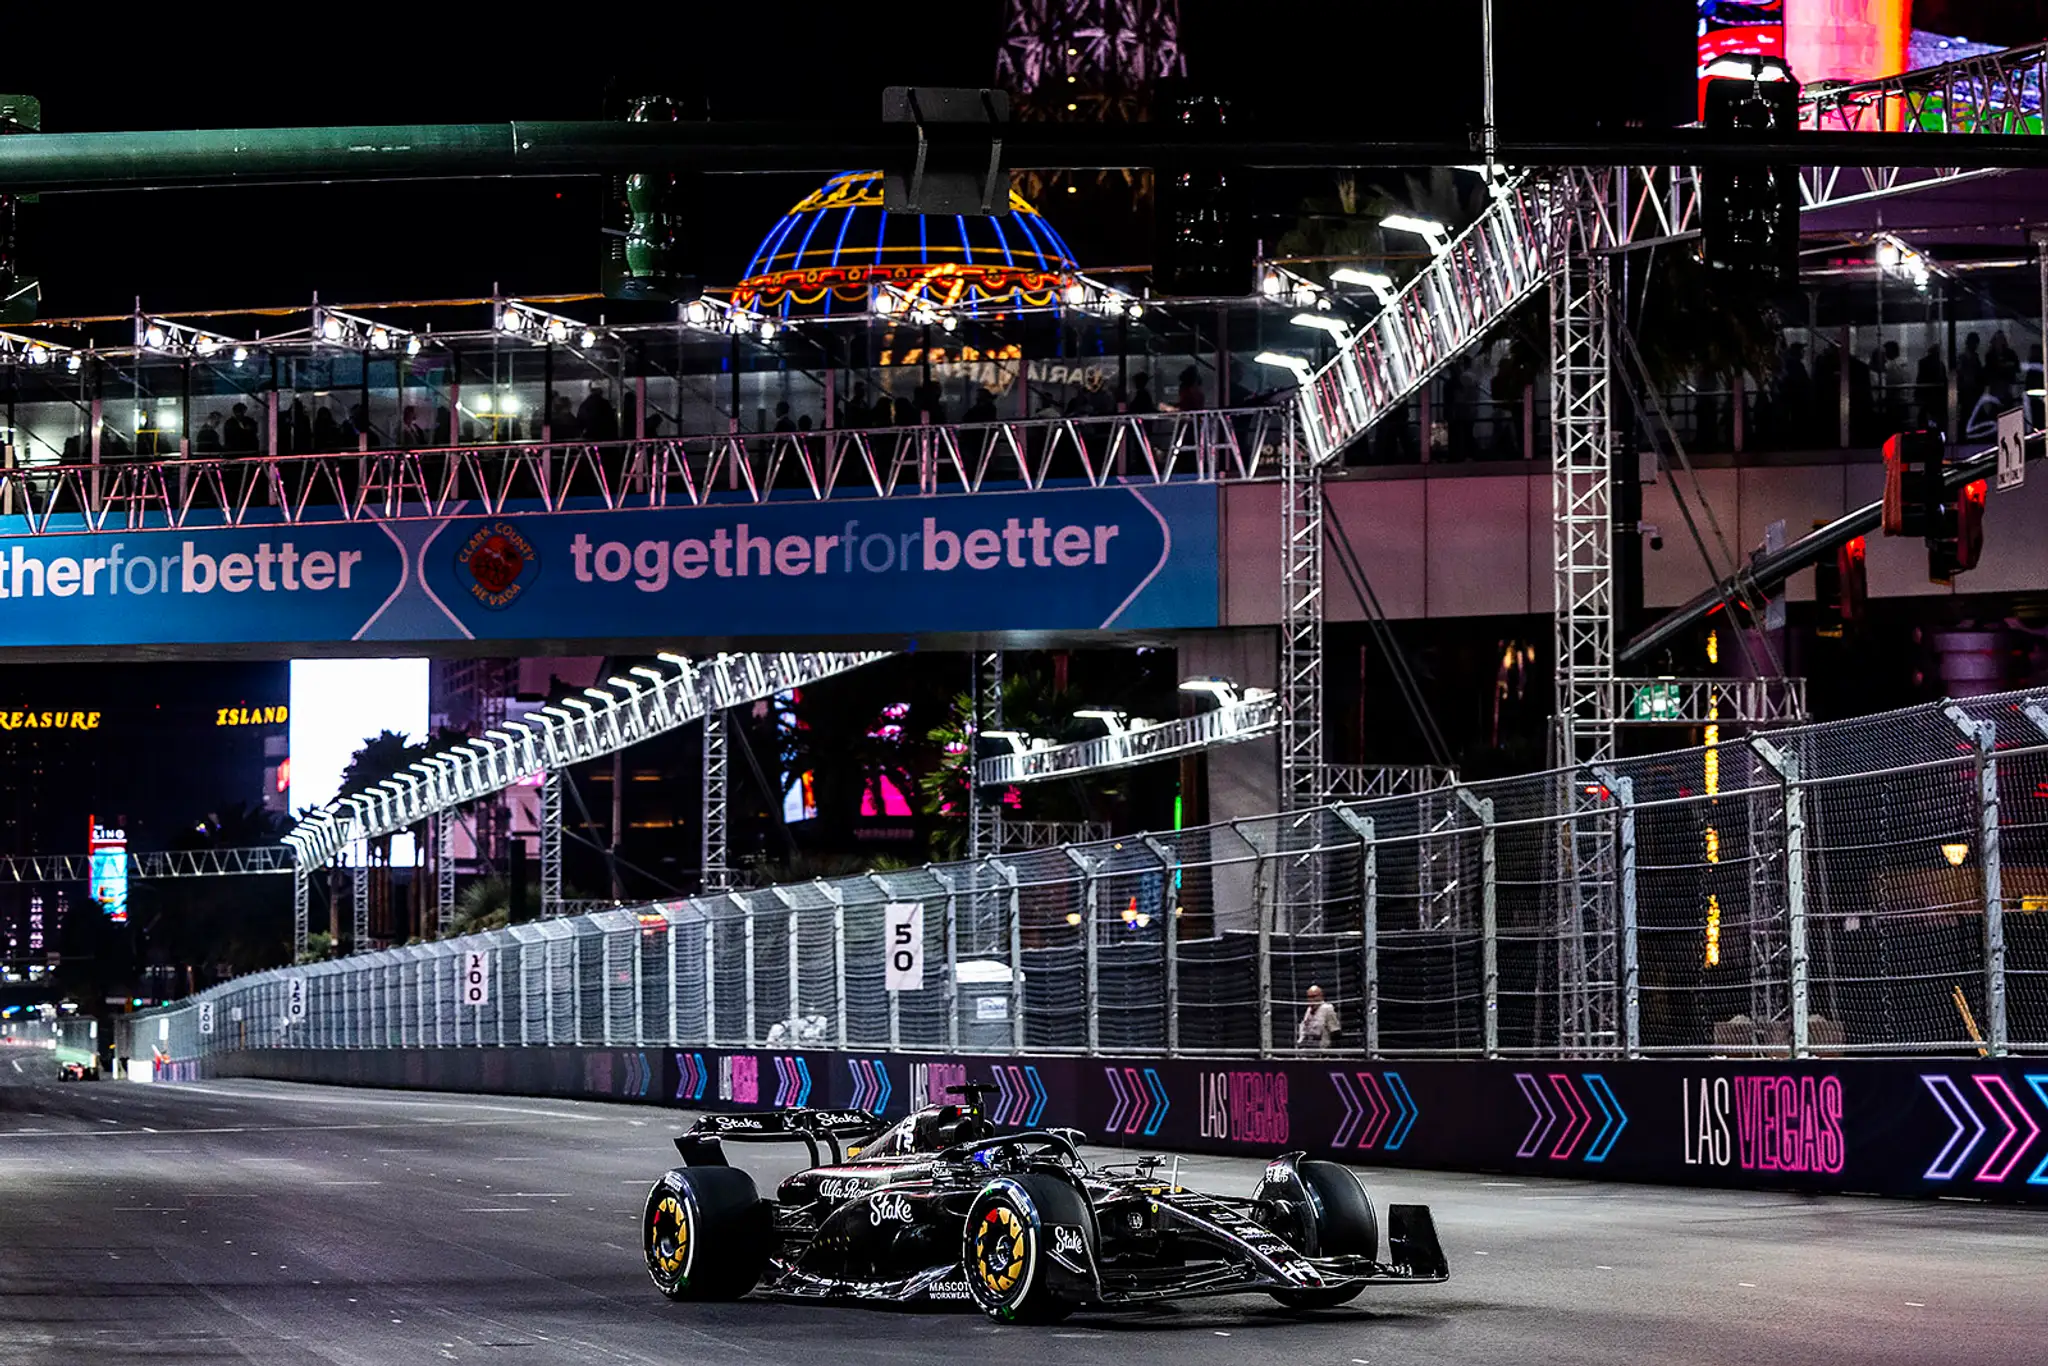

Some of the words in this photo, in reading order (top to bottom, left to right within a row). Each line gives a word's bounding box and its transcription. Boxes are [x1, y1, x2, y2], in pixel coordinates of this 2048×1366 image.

[216, 705, 288, 726] ISLAND
[894, 923, 913, 971] 50
[469, 954, 482, 1001] 100
[292, 981, 301, 1015] 150
[716, 1116, 763, 1129] Stake
[816, 1112, 863, 1126] Stake
[1200, 1072, 1228, 1139] LAS
[1229, 1072, 1289, 1144] VEGAS
[1683, 1077, 1731, 1166] LAS
[1734, 1075, 1845, 1173] VEGAS
[820, 1178, 842, 1204] Alfa
[870, 1193, 914, 1226] Stake
[1055, 1226, 1083, 1254] Stake
[929, 1281, 968, 1291] MASCOT
